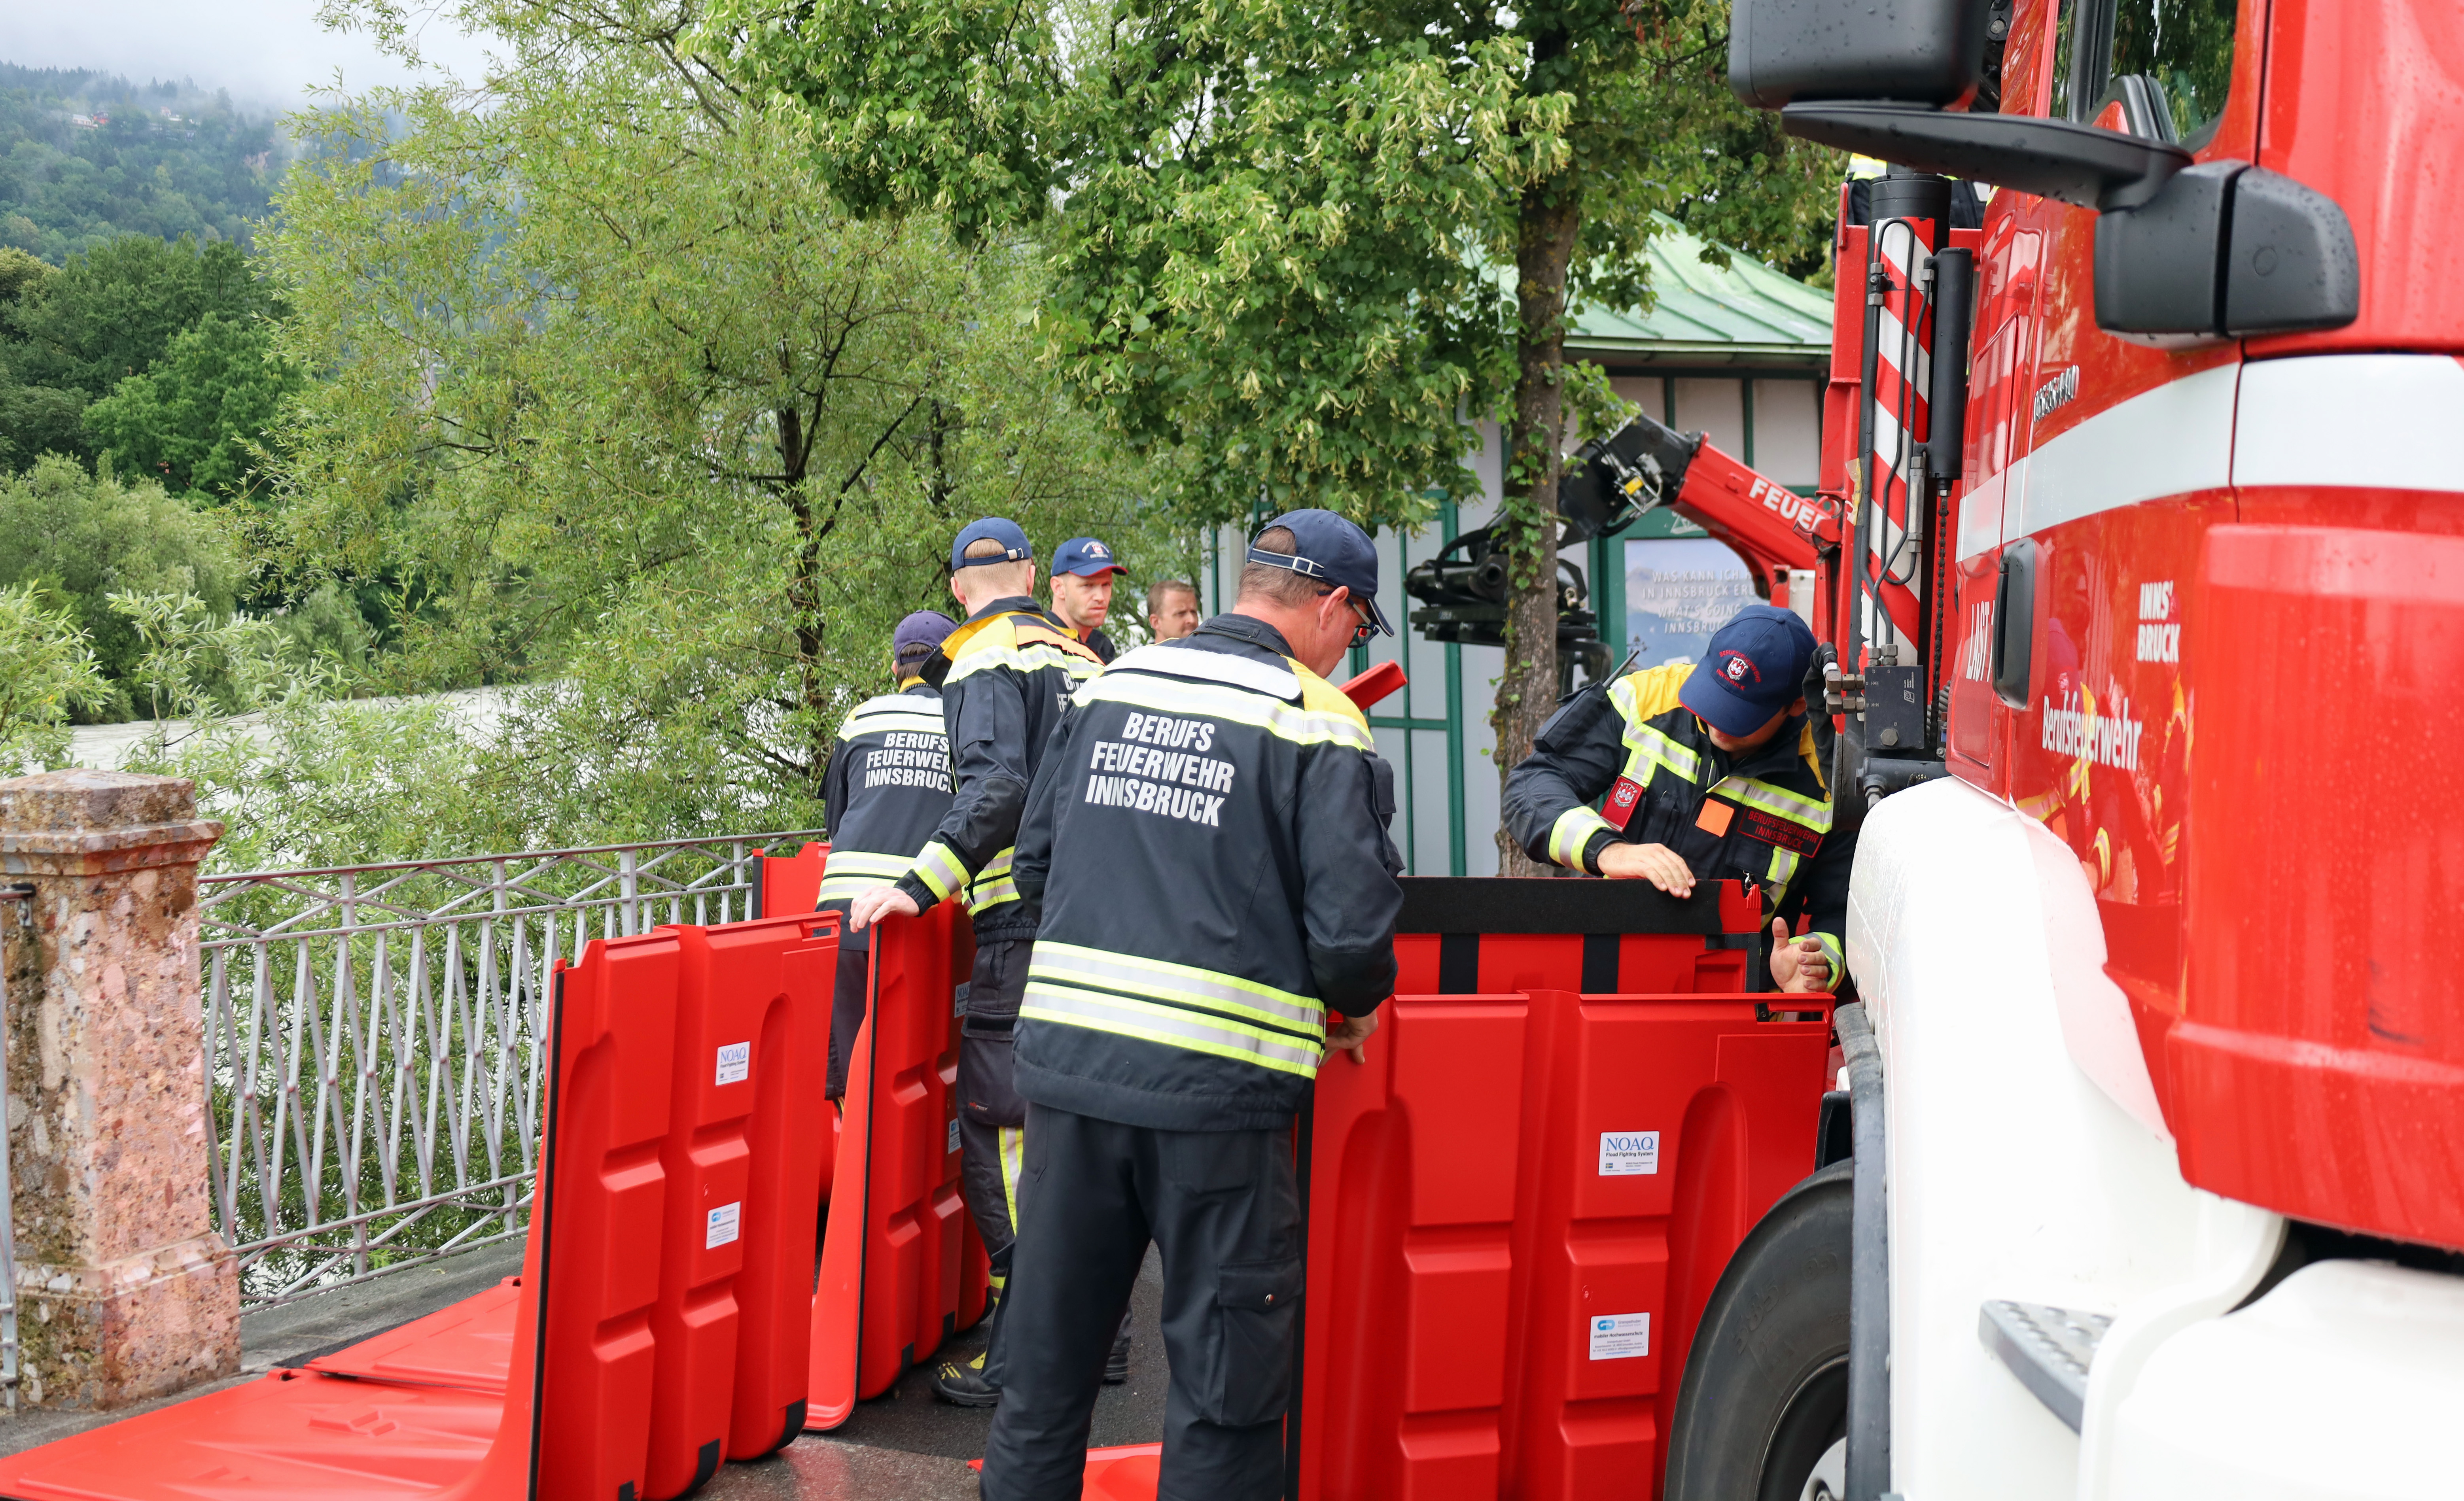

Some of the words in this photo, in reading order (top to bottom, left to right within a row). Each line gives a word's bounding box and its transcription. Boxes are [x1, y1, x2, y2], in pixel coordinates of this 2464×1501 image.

[1652, 571, 1678, 583] WAS
[1682, 570, 1715, 582] KANN
[1720, 569, 1740, 581] ICH
[1642, 588, 1655, 599] IN
[1662, 585, 1729, 598] INNSBRUCK
[1658, 604, 1701, 618] WHAT'S
[1705, 603, 1741, 617] GOING
[1966, 601, 1990, 682] LAST
[2137, 623, 2181, 663] BRUCK
[1716, 668, 1746, 691] INNSBRUCK
[1719, 650, 1762, 683] BERUFSFEUERWEHR
[884, 732, 949, 752] BERUFS
[1122, 711, 1215, 752] BERUFS
[2042, 690, 2142, 771] Berufsfeuerwehr
[1090, 741, 1235, 794] FEUERWEHR
[865, 768, 952, 794] INNSBRUC
[1085, 774, 1226, 827] INNSBRUCK
[1748, 811, 1819, 844] BERUFSFEUERWEHR
[1755, 825, 1804, 849] INNSBRUCK
[720, 1047, 746, 1064] NOAQ
[1606, 1137, 1654, 1151] NOAQ
